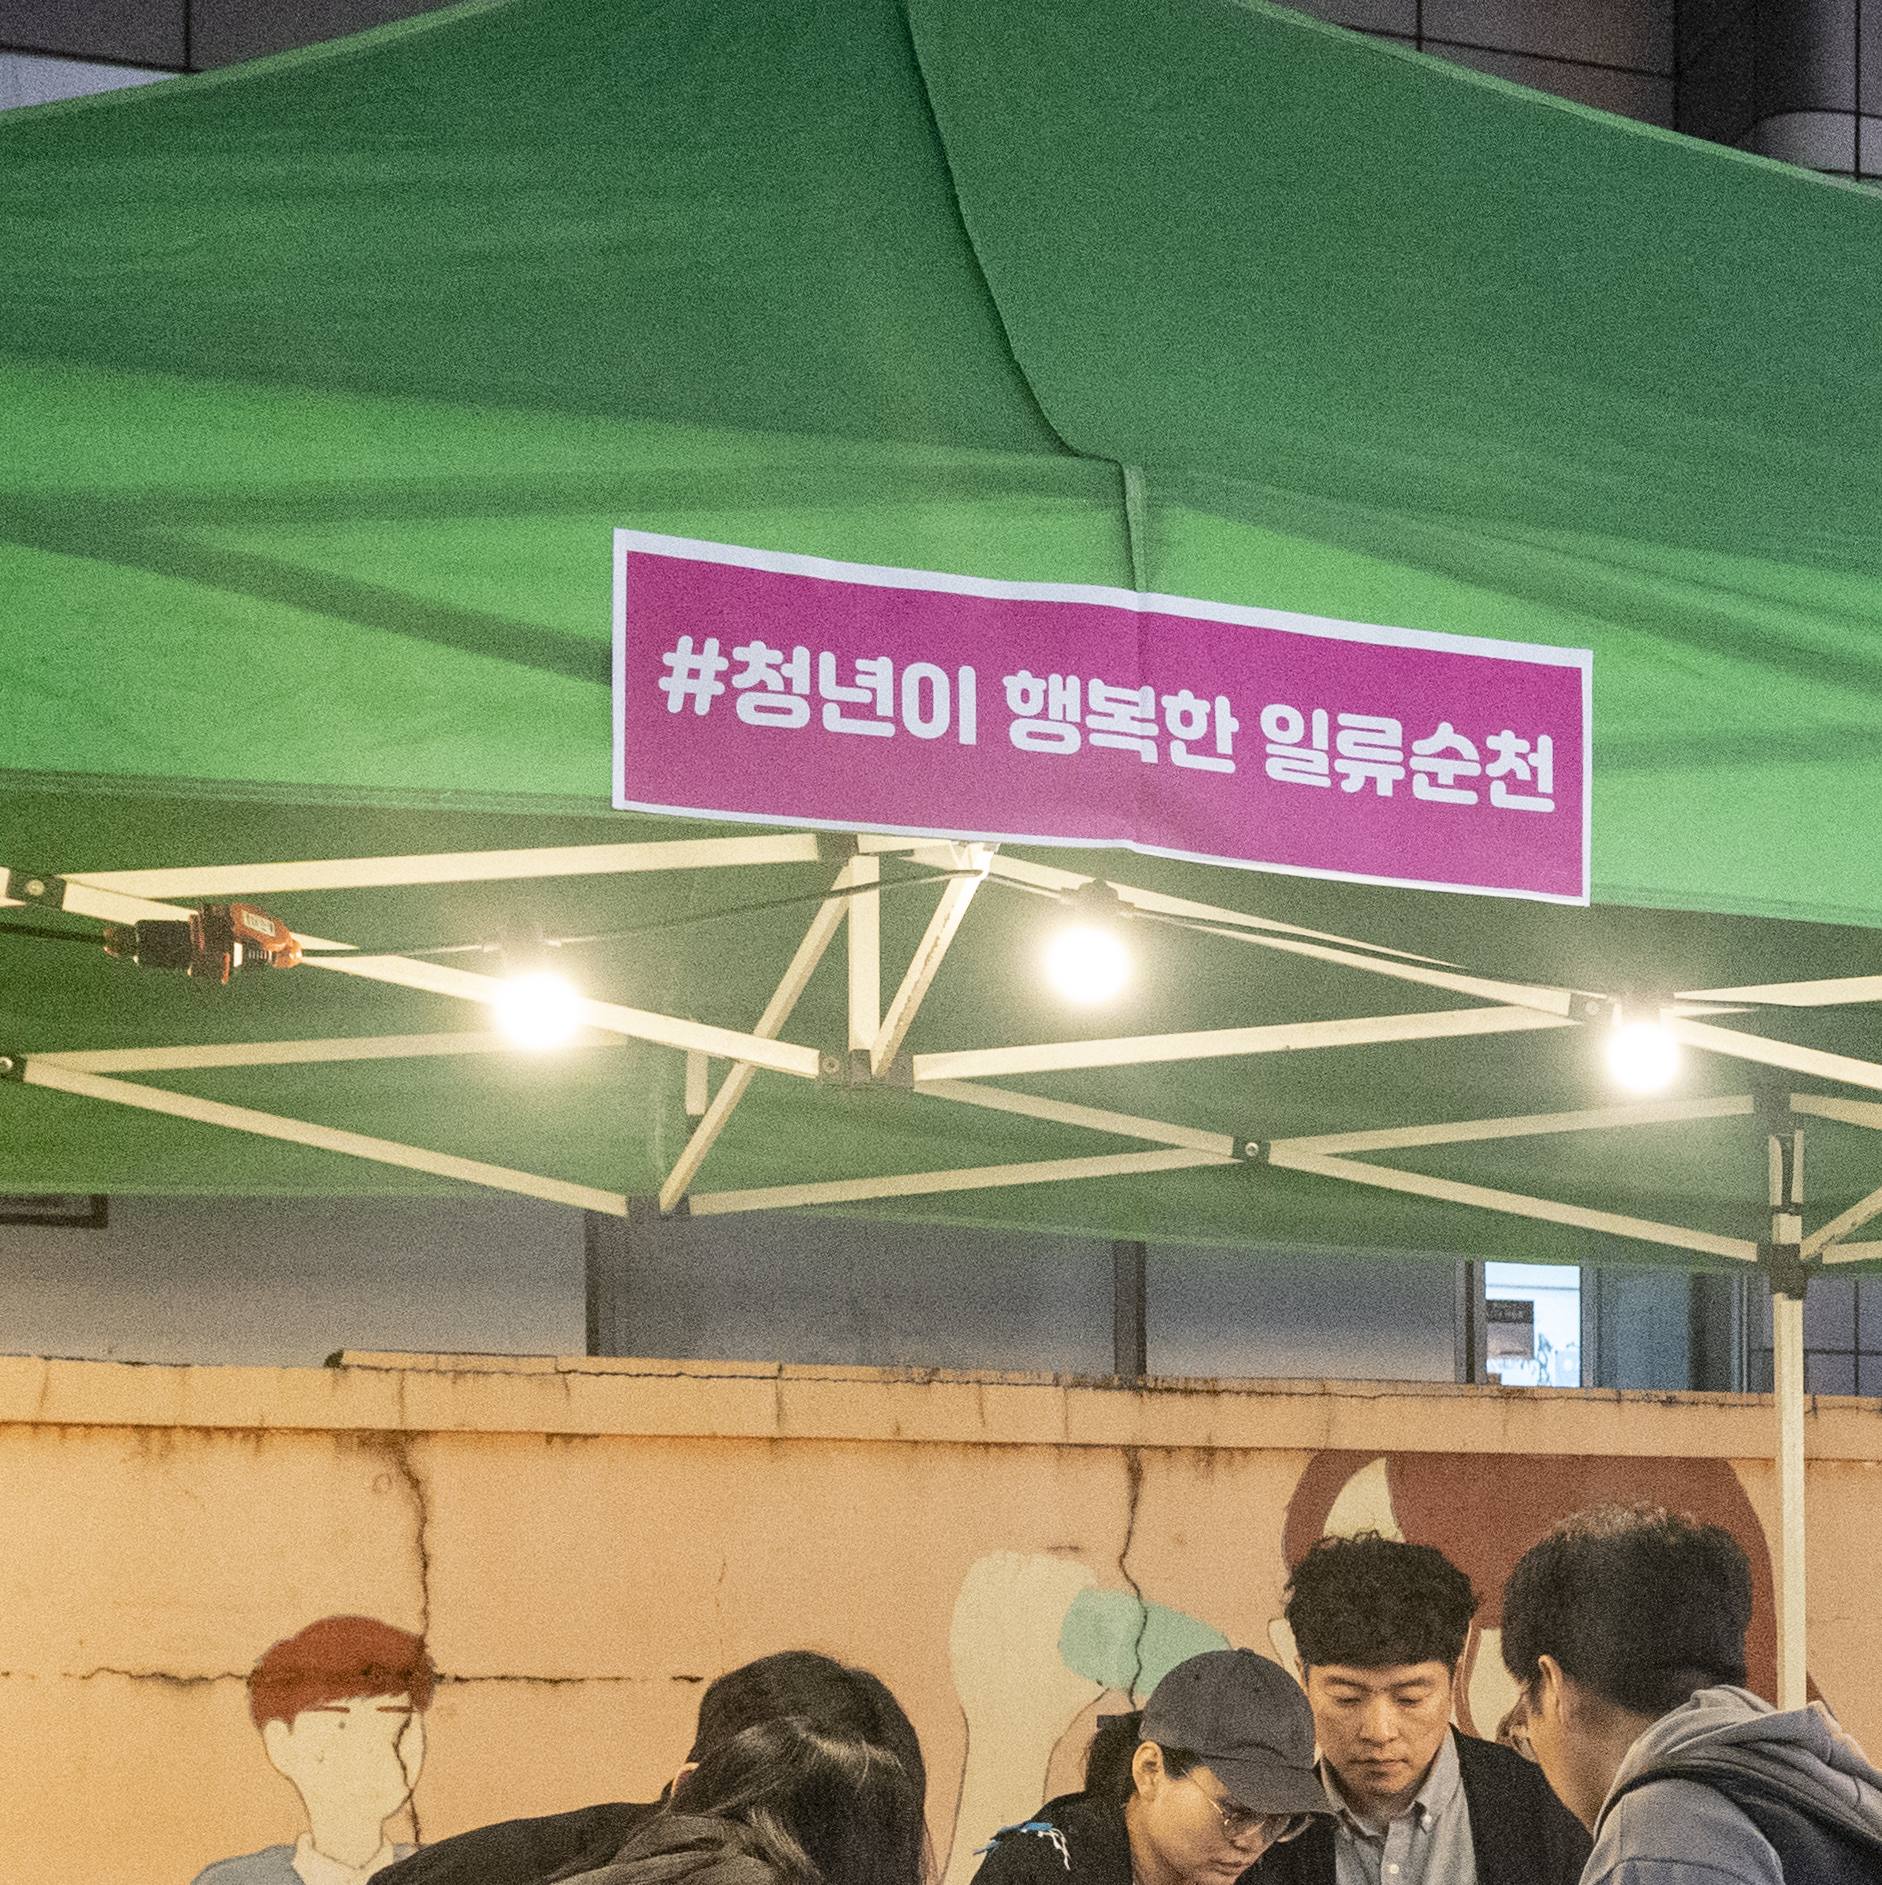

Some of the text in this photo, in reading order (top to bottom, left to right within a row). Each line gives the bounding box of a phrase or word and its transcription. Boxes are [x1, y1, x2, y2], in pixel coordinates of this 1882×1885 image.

[658, 635, 1555, 813] #청년이 행복한 일류순천
